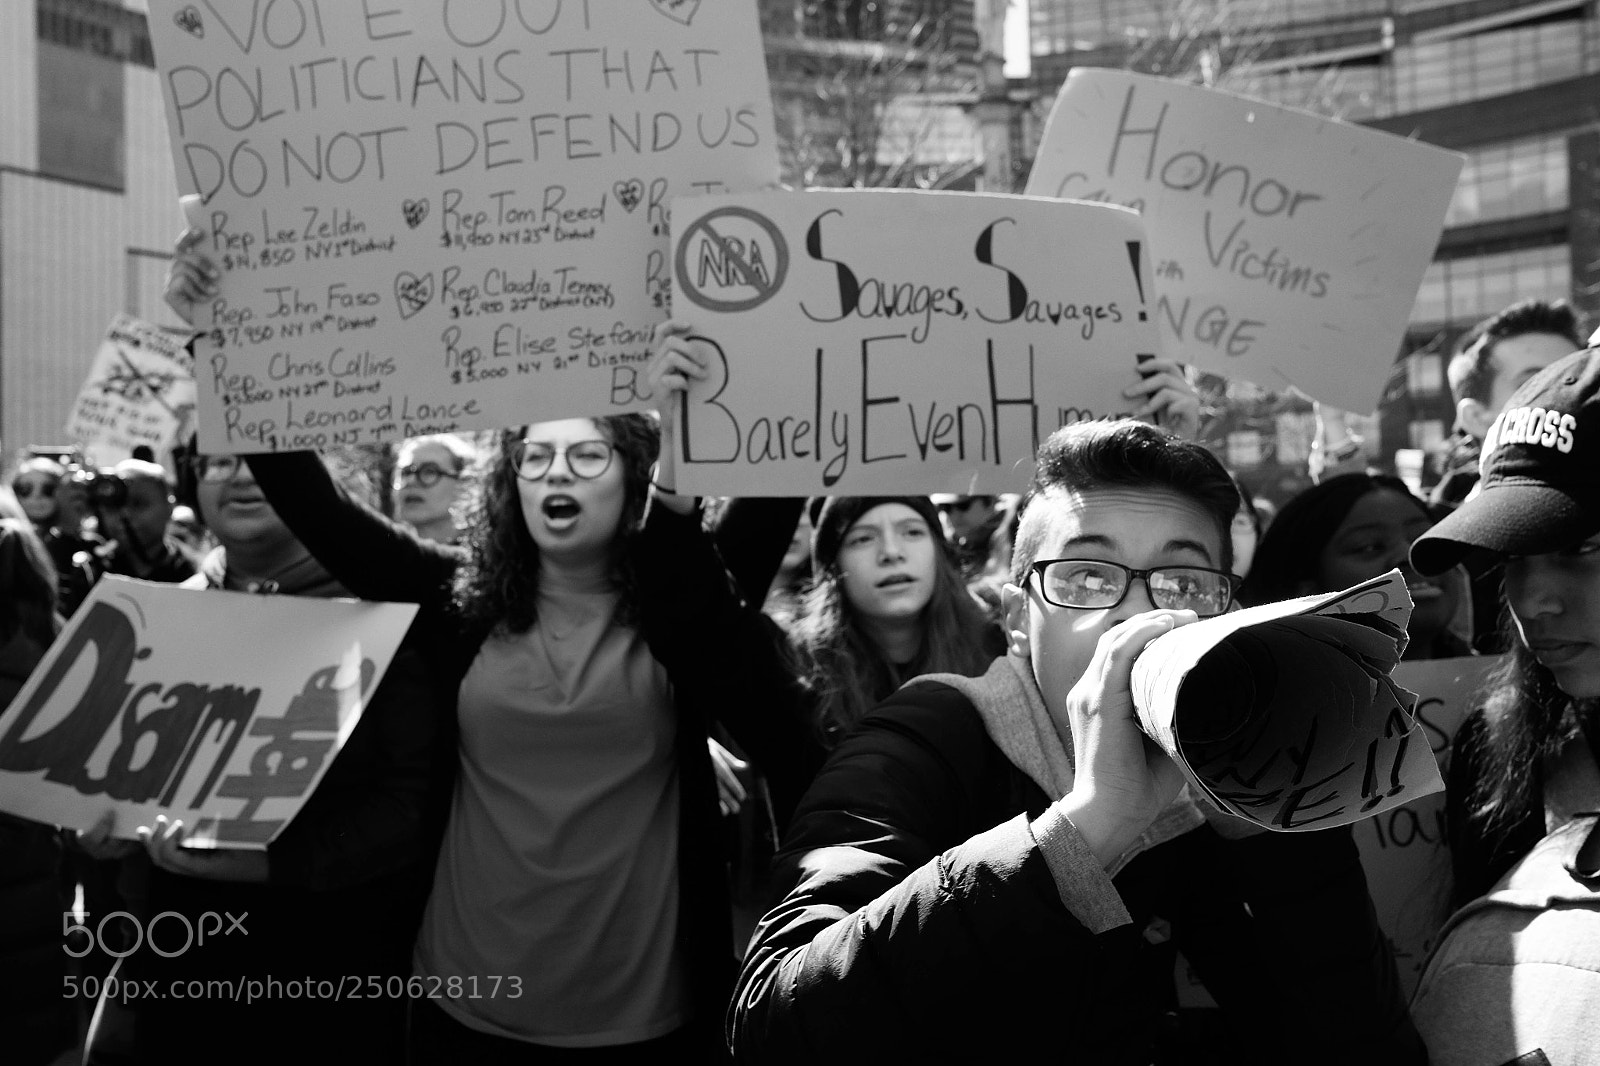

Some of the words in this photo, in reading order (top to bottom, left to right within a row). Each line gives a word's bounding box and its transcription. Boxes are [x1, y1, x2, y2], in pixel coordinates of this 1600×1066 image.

[168, 50, 525, 138] POLITICIANS
[549, 47, 719, 101] THAT
[184, 138, 267, 206] DO
[282, 127, 408, 188] NOT
[436, 112, 682, 175] DEFEND
[697, 106, 760, 149] US
[1108, 85, 1322, 218] Honor
[262, 208, 298, 245] Lee
[302, 207, 366, 241] Zeldin
[489, 190, 535, 227] Tom
[542, 185, 607, 227] Reed
[697, 236, 770, 288] NRA
[1204, 210, 1331, 299] Victims
[263, 285, 318, 319] John
[328, 282, 381, 309] Faso
[492, 322, 557, 358] Elise
[1157, 295, 1266, 357] NGE
[267, 352, 326, 381] Chris
[327, 347, 397, 378] Collins
[517, 361, 542, 375] NY
[588, 350, 653, 368] District
[286, 395, 393, 430] Leonard
[401, 396, 482, 421] Lance
[679, 334, 849, 487] Barely
[860, 333, 987, 464] Even
